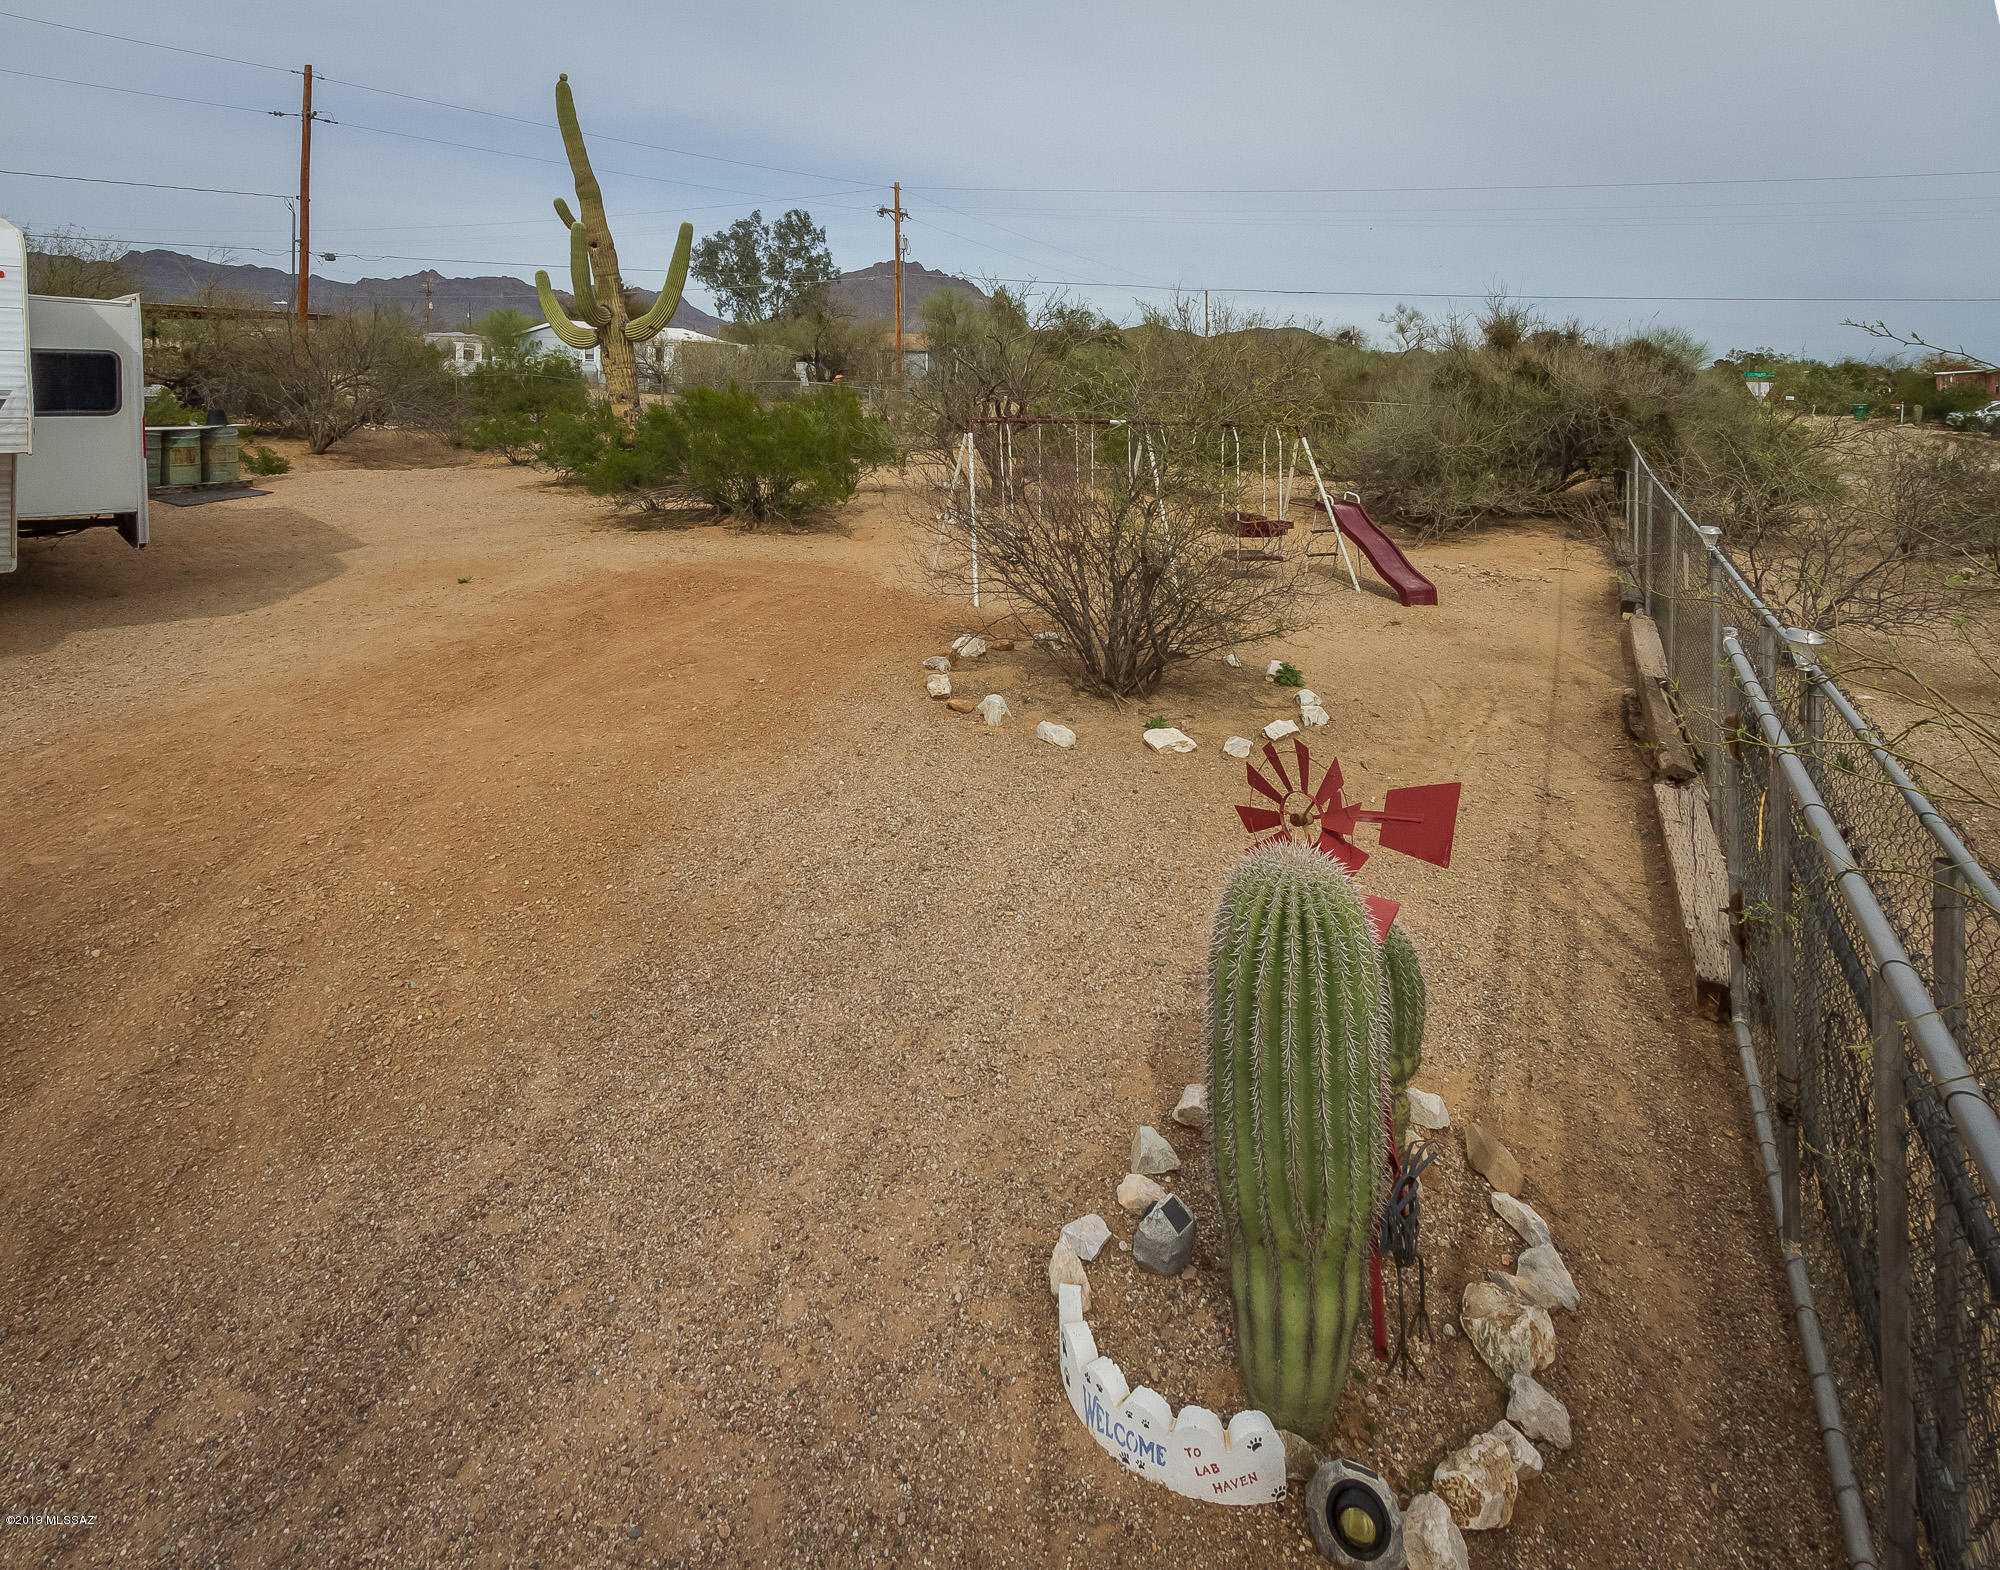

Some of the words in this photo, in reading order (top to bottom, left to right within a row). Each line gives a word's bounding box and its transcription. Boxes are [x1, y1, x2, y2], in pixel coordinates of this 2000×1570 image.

[1082, 1384, 1168, 1467] WELCOME
[1184, 1447, 1202, 1459] TO
[1195, 1463, 1221, 1477] LAB
[1212, 1471, 1259, 1494] HAVEN
